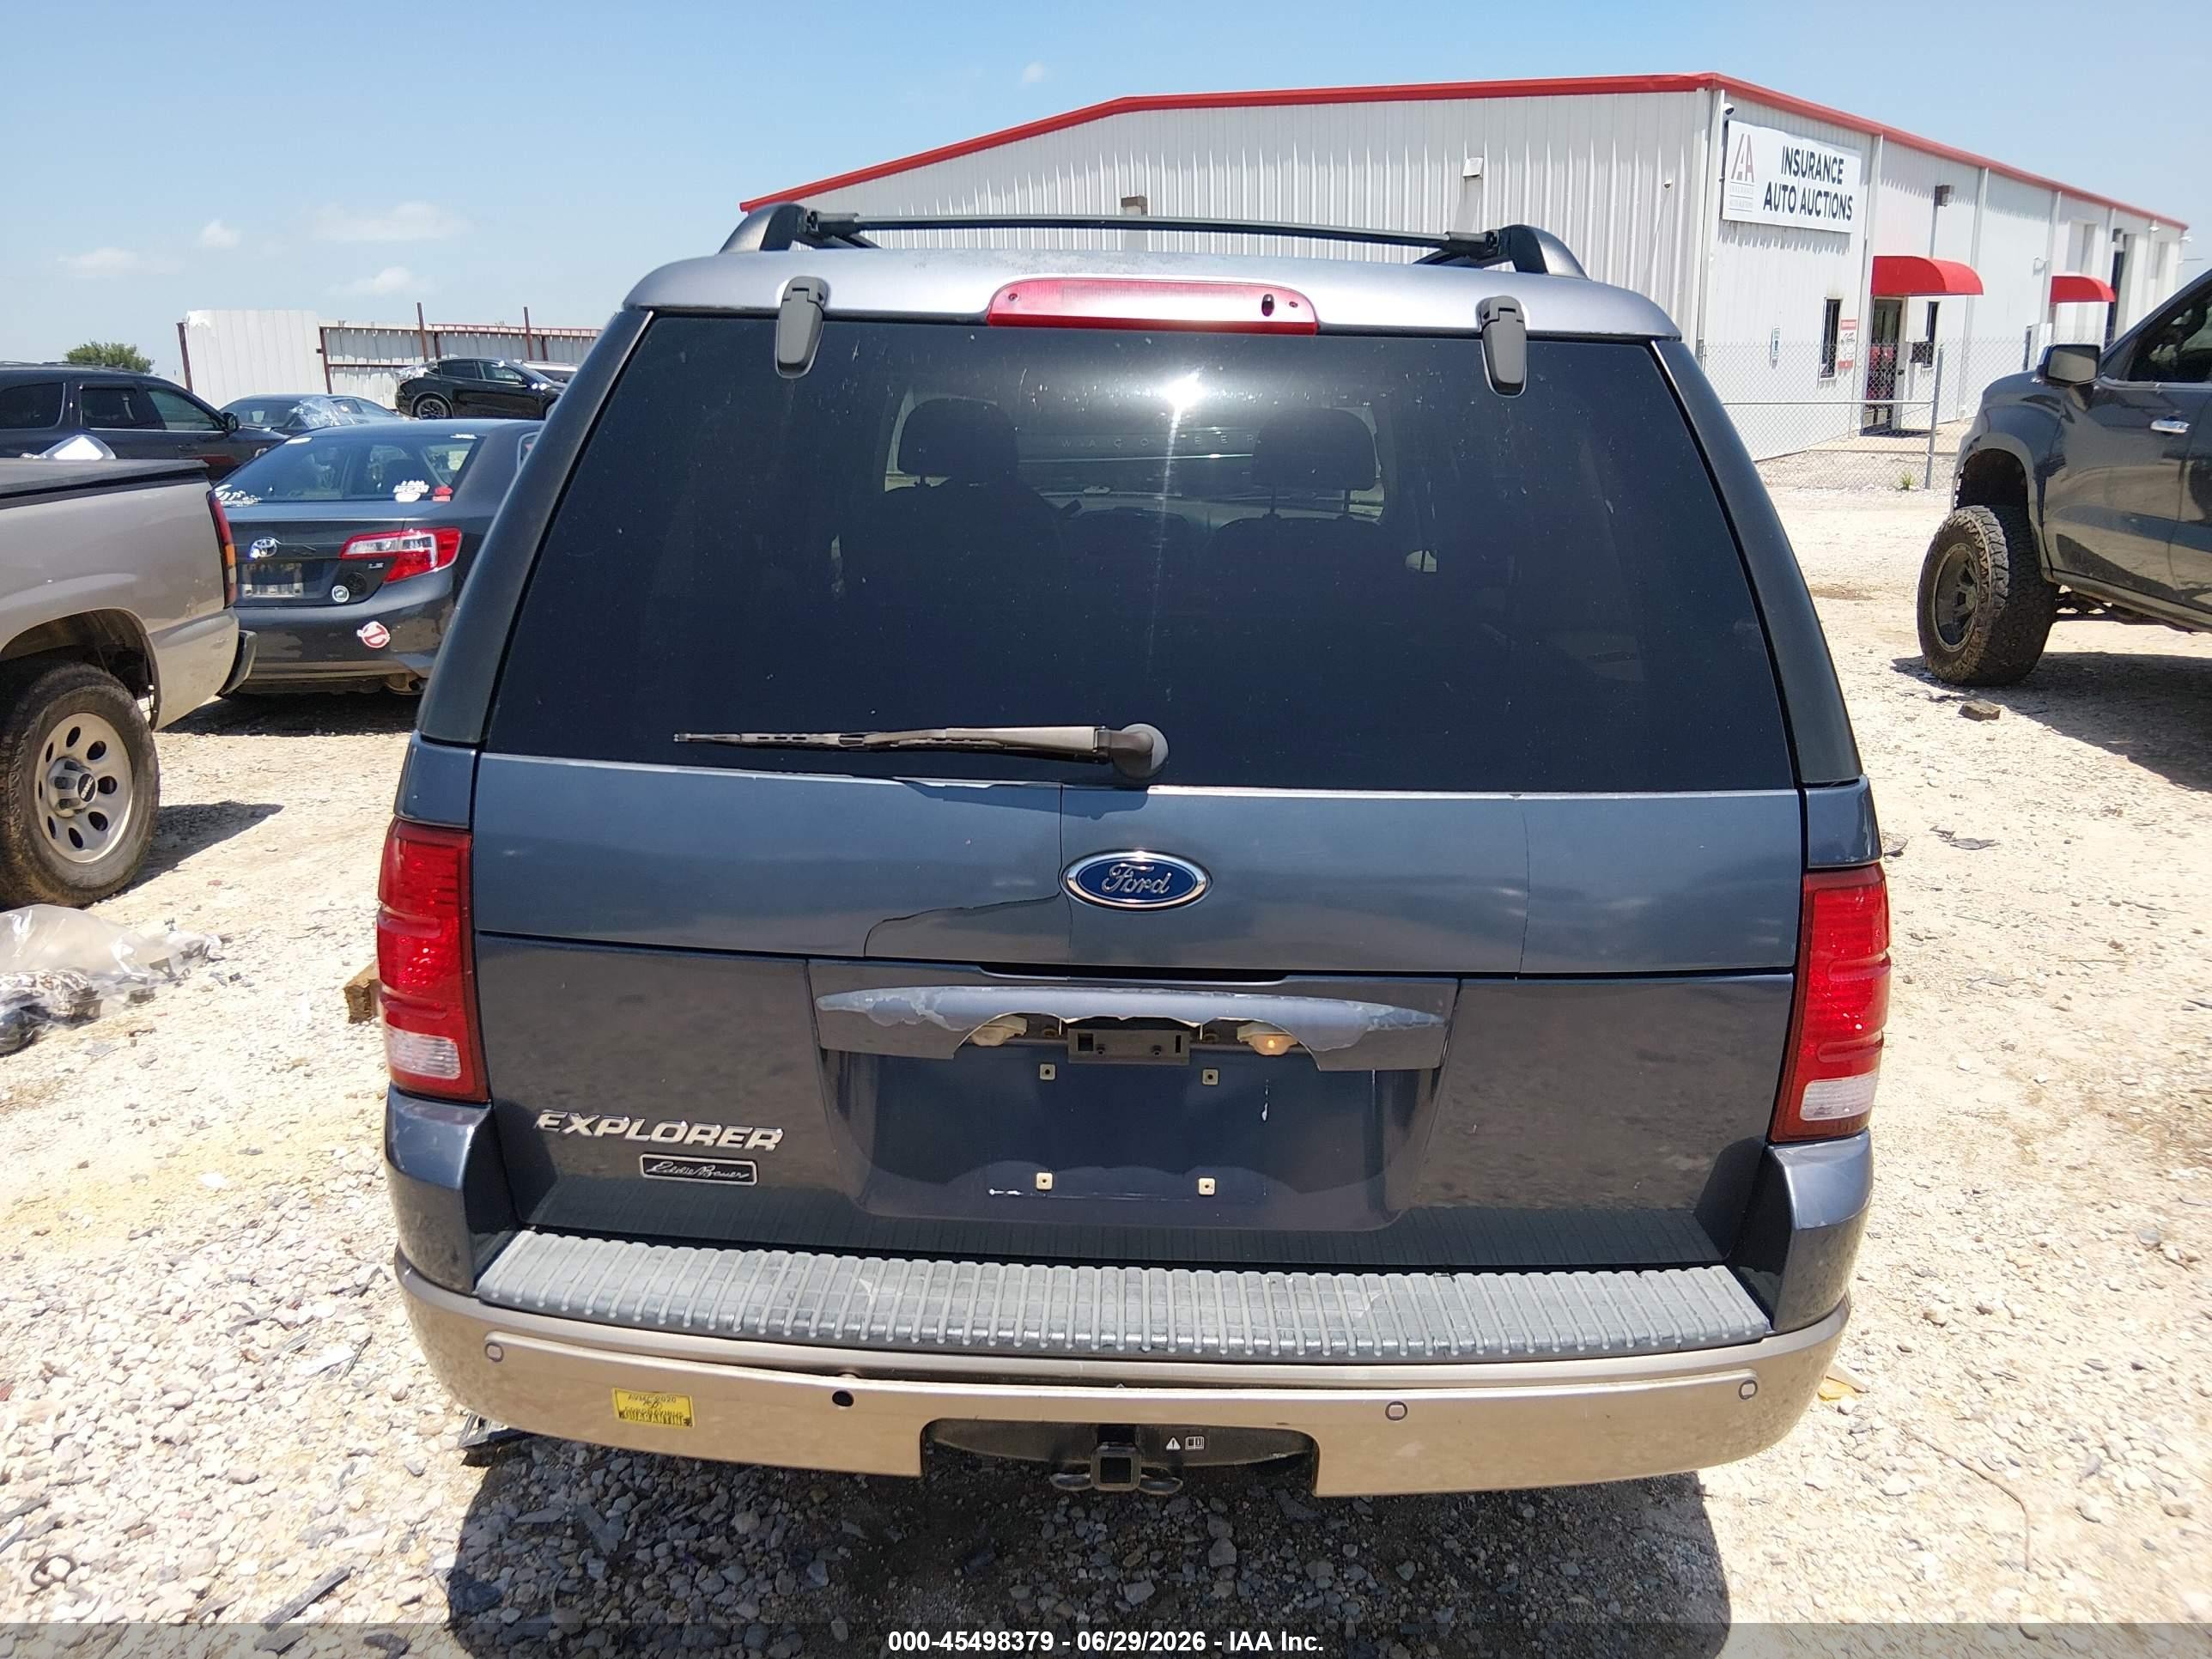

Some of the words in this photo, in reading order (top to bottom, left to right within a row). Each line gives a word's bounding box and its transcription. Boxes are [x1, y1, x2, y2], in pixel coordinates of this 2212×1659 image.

[1781, 145, 1844, 185] INSURANCE
[1763, 181, 1797, 214] AUTO
[1799, 187, 1853, 222] AUCTIONS
[81, 776, 94, 799] GMC
[1101, 862, 1171, 895] Ford
[533, 1109, 784, 1152] EXPLORER
[646, 1160, 696, 1176] Eddie
[694, 1164, 750, 1179] Bauer
